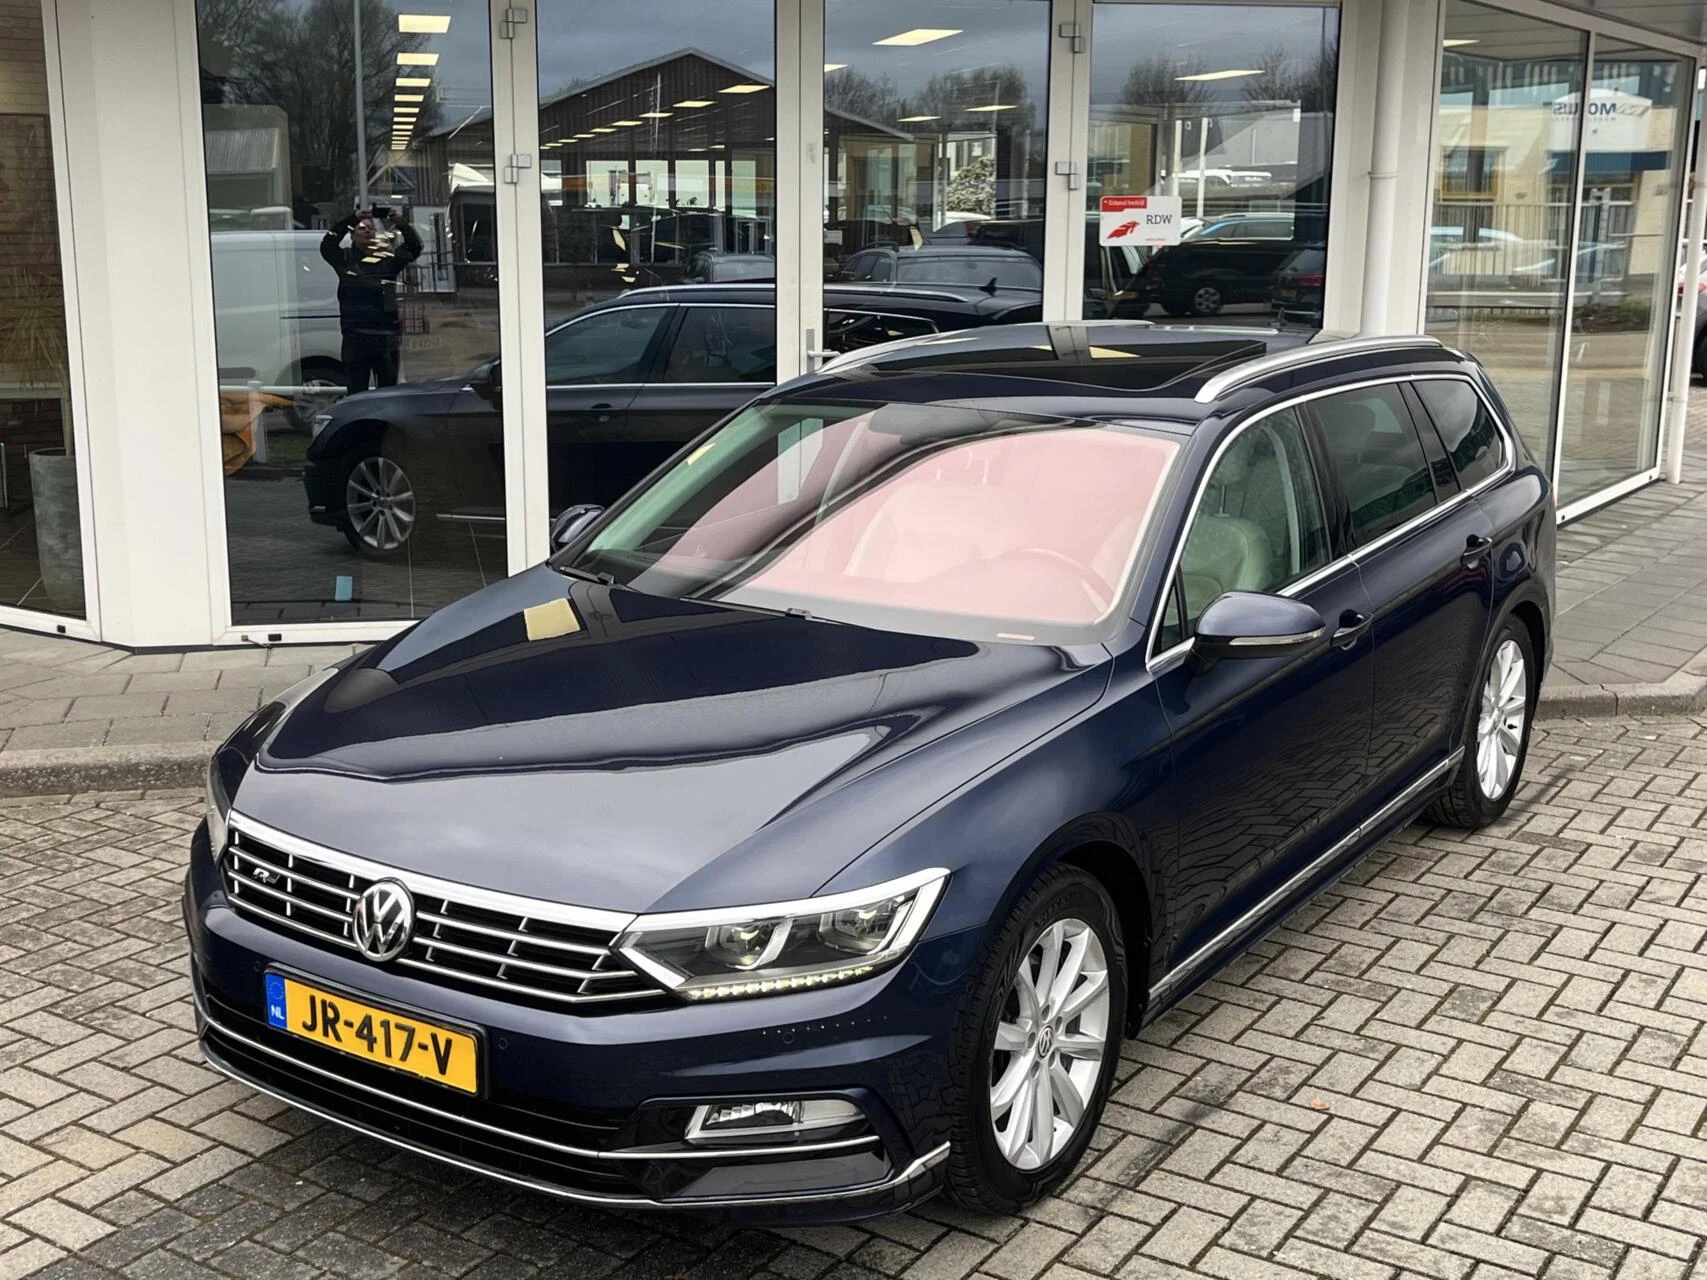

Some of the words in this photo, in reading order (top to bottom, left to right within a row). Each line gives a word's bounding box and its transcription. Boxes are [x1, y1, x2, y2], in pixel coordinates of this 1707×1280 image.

[1146, 214, 1172, 225] RDW
[270, 1004, 285, 1021] NL
[302, 994, 453, 1076] JR-417-V
